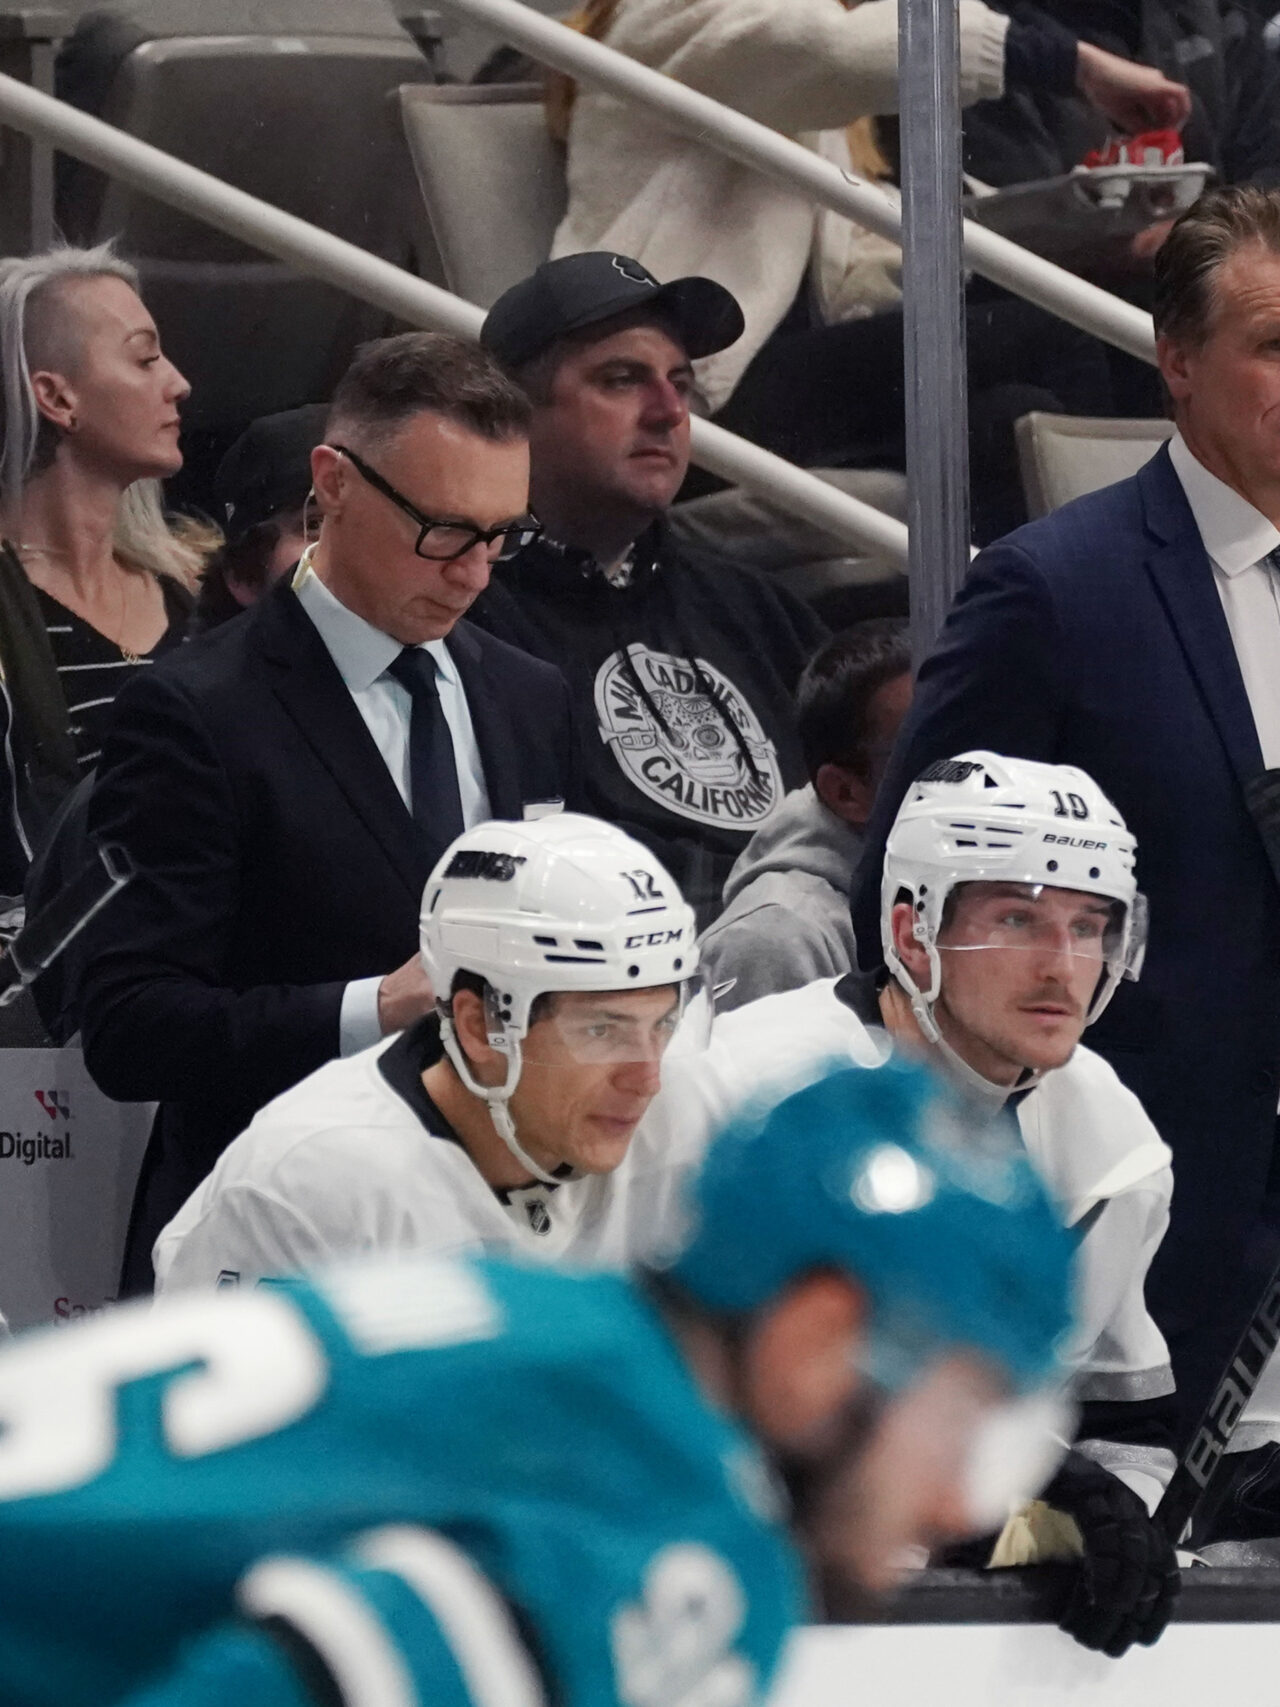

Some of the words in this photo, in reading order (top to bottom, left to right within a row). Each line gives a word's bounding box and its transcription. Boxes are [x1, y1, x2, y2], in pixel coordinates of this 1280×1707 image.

[1049, 789, 1090, 820] 10
[619, 868, 664, 901] 12
[625, 928, 683, 950] CCM
[0, 1132, 72, 1166] Digital
